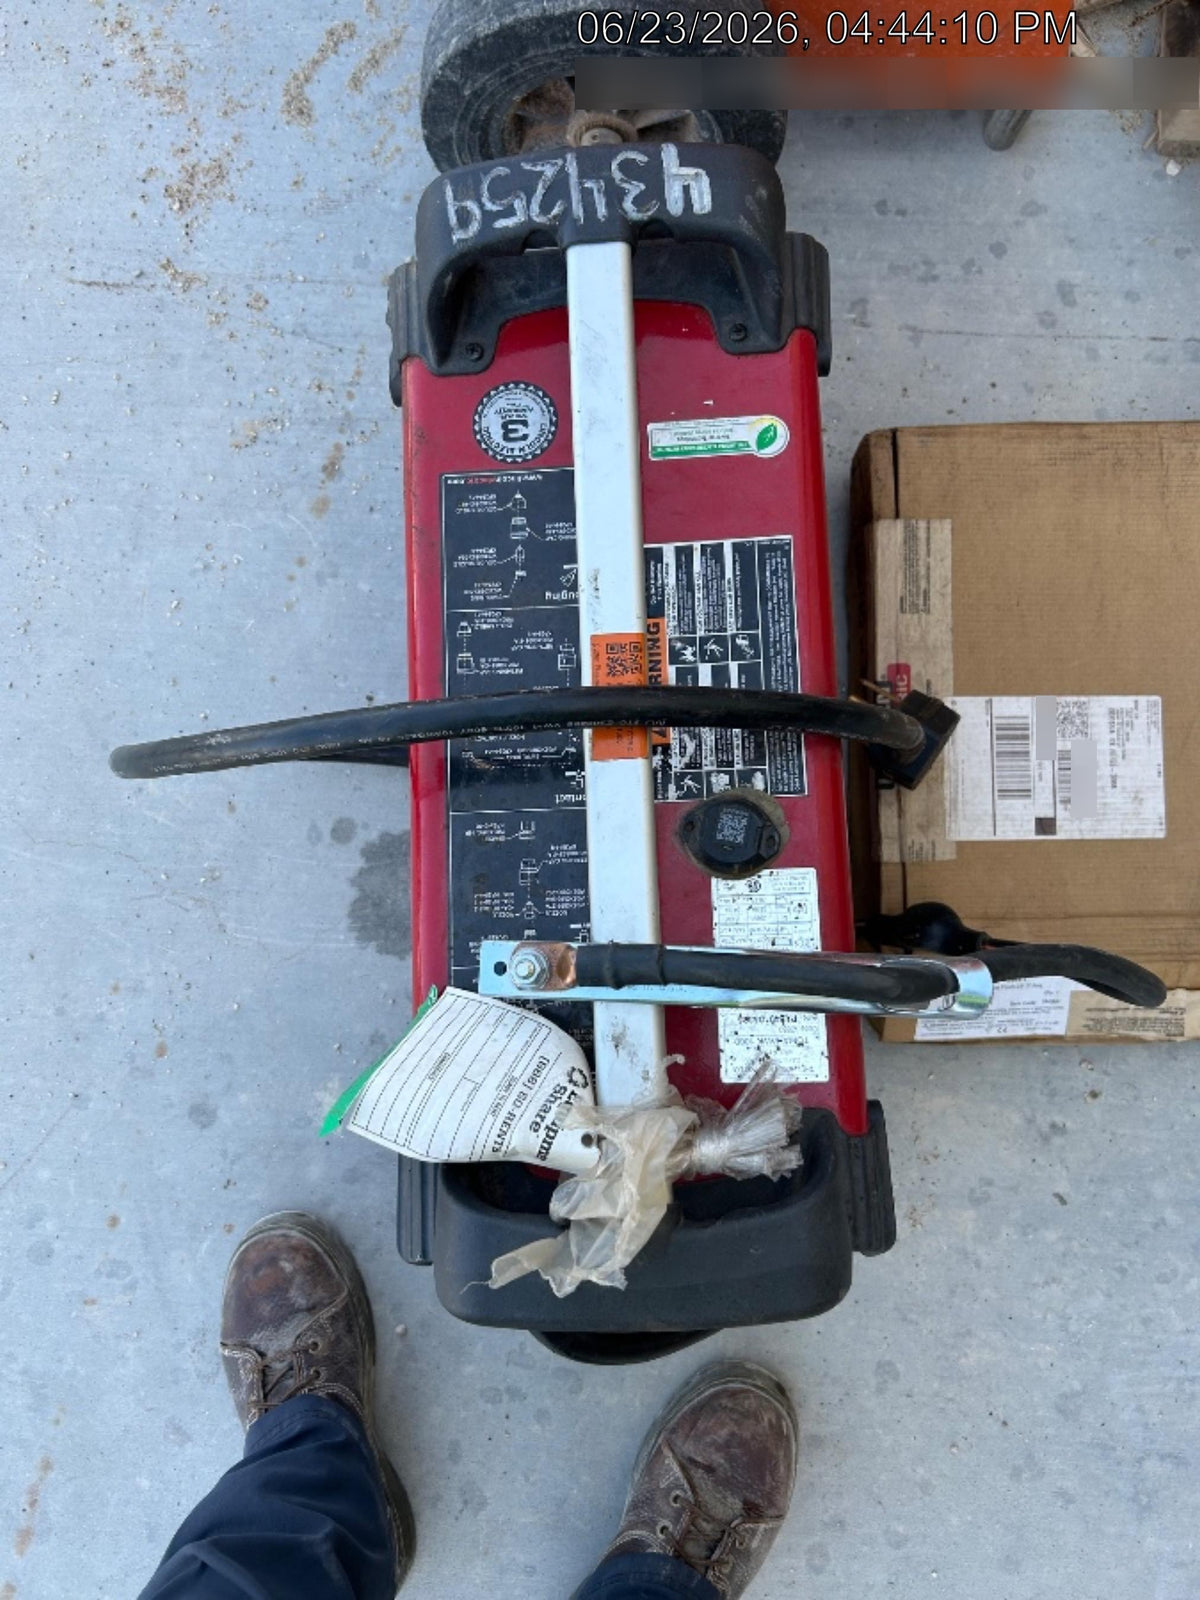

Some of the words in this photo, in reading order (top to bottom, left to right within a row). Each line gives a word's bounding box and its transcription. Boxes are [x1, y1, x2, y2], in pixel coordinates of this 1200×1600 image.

[443, 143, 712, 244] 434259
[501, 420, 529, 442] 3
[647, 621, 661, 686] RNING
[529, 1083, 568, 1135] Share
[536, 1089, 579, 1162] Eipme
